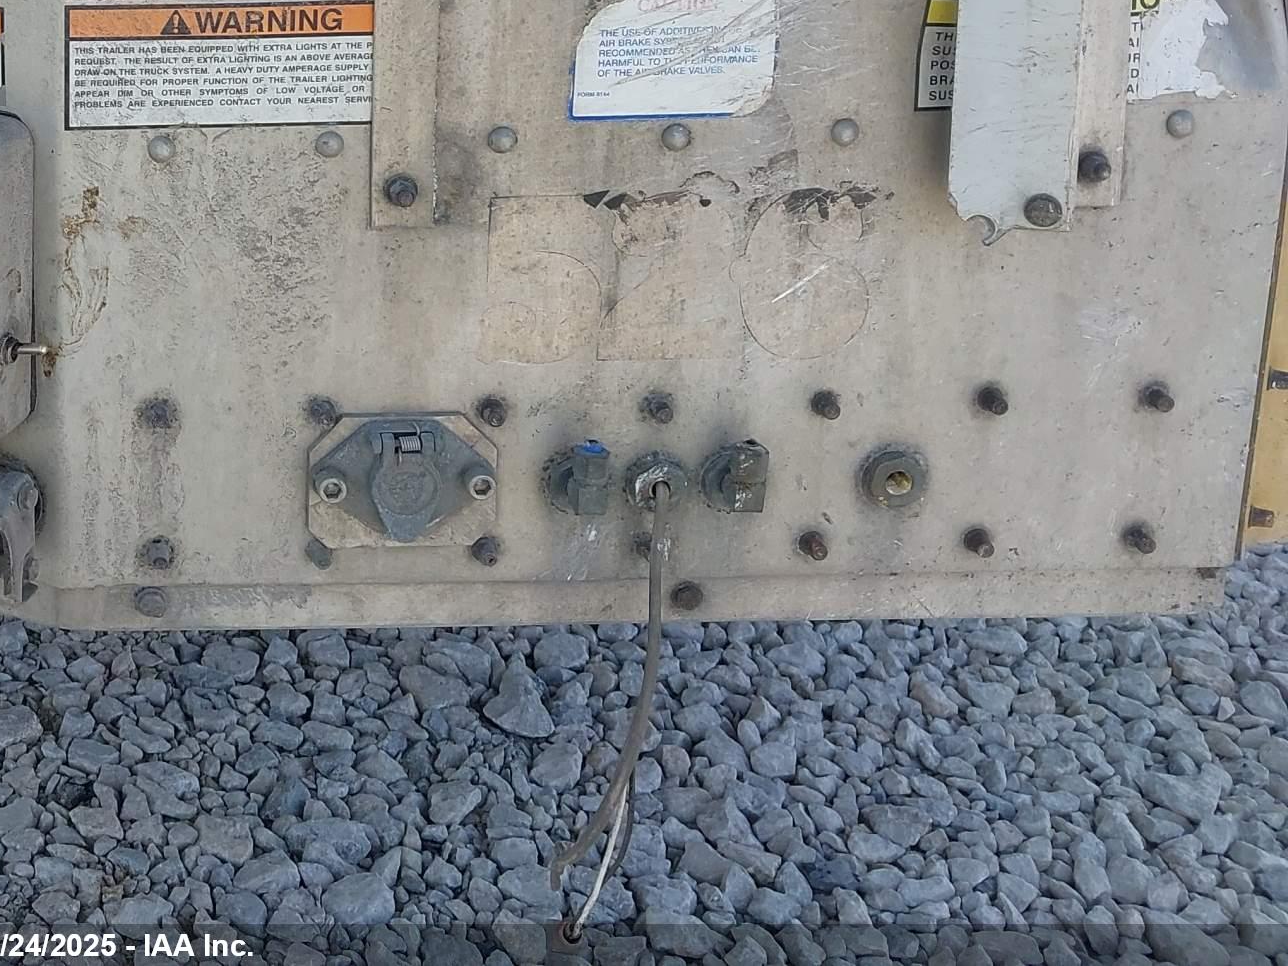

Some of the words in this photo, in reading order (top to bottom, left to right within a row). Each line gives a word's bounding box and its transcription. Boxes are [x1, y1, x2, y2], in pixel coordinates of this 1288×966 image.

[195, 7, 344, 33] WARNING
[599, 29, 619, 37] THE
[622, 28, 641, 37] USE
[643, 27, 659, 36] OF
[98, 46, 135, 54] TRAILER
[138, 46, 157, 54] HAS
[160, 45, 185, 53] BEEN
[188, 45, 234, 53] EQUIPPED
[237, 44, 260, 52] WITH
[263, 43, 292, 51] EXTRA
[295, 42, 328, 51] LIGHTS
[330, 42, 342, 50] AT
[346, 41, 363, 49] THE
[599, 39, 616, 47] AIR
[618, 38, 651, 47] BRAKE
[598, 47, 676, 57] RECOMMENDED
[598, 58, 645, 67] HARMFUL
[648, 57, 661, 66] TO
[74, 69, 100, 77] DRAW
[103, 68, 117, 76] ON
[119, 68, 137, 76] THE
[172, 67, 210, 75] SYSTEM.
[224, 66, 253, 74] HEAVY
[256, 65, 280, 73] DUTY
[282, 64, 332, 73] AMPERAGE
[334, 63, 369, 72] SUPPLY
[597, 69, 612, 78] OF
[613, 69, 633, 77] THE
